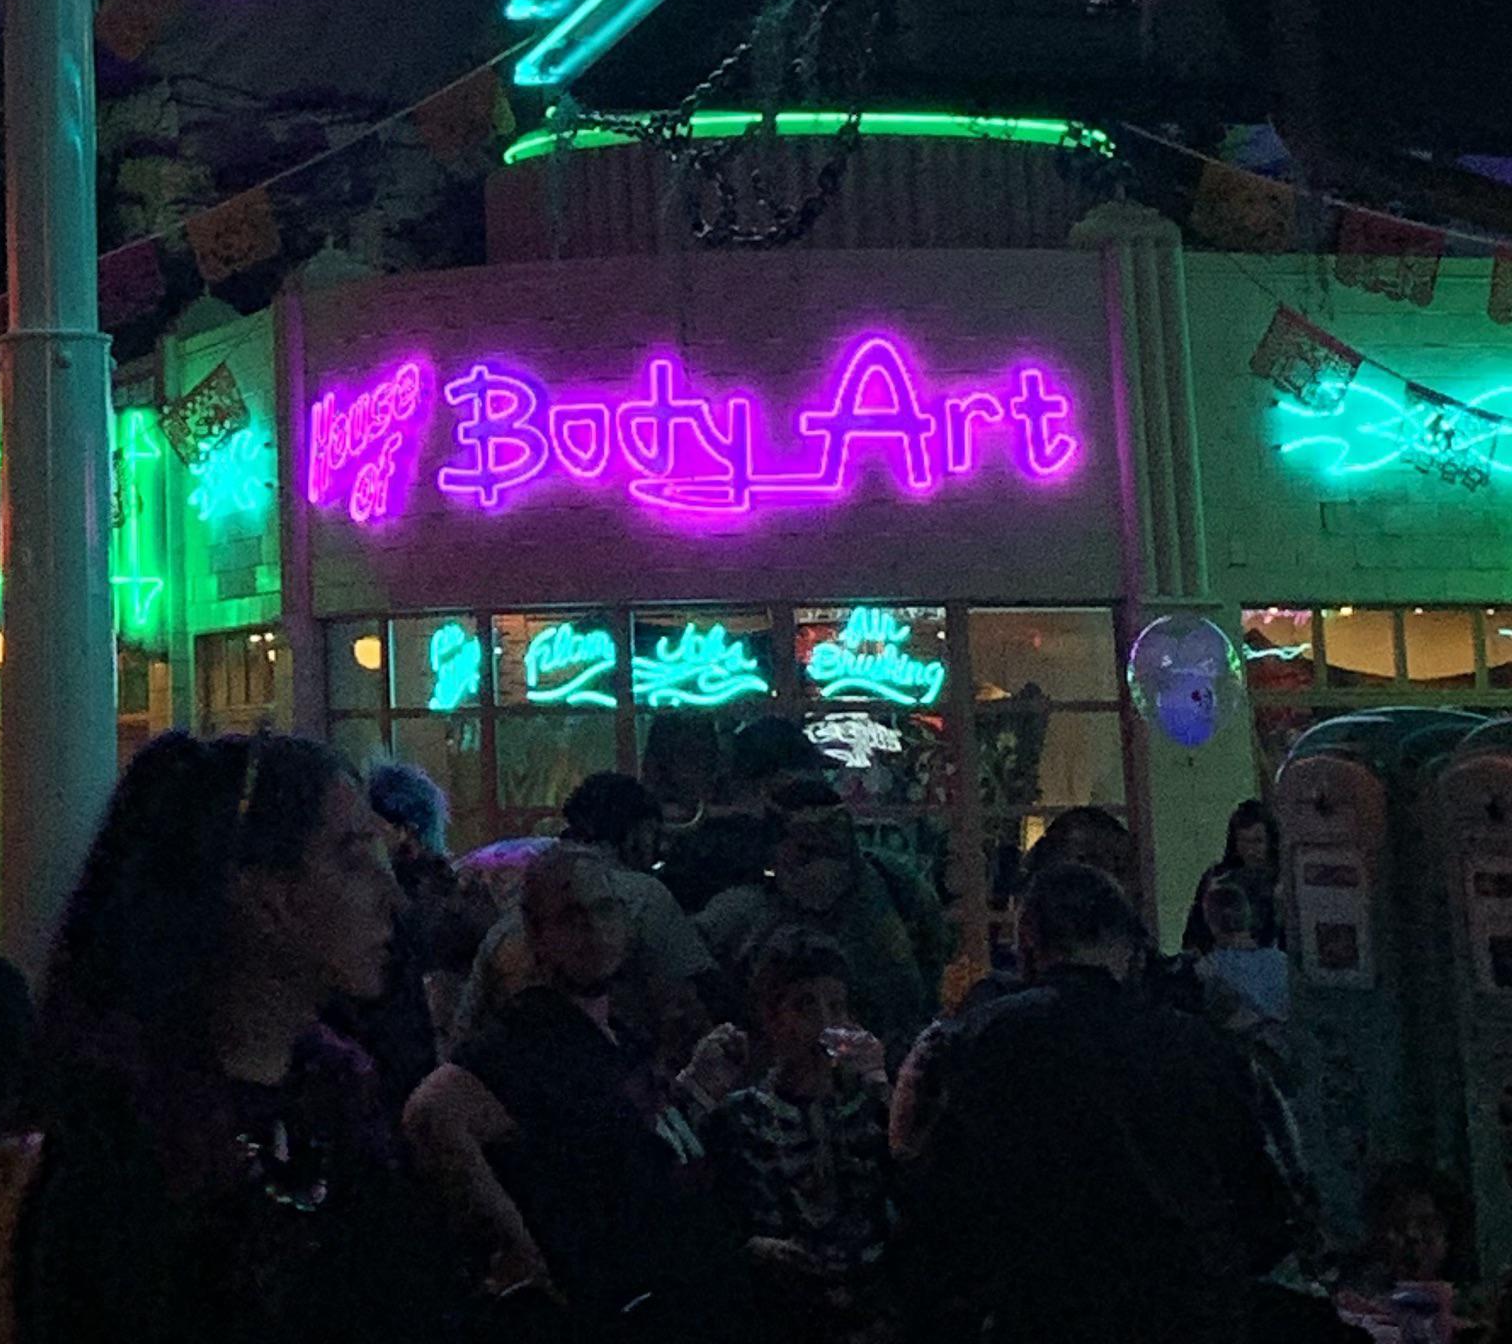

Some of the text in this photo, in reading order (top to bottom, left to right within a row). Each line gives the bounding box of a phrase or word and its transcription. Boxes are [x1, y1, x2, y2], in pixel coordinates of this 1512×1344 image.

[307, 360, 422, 504] House
[348, 431, 404, 523] of
[437, 332, 1082, 512] Body Art
